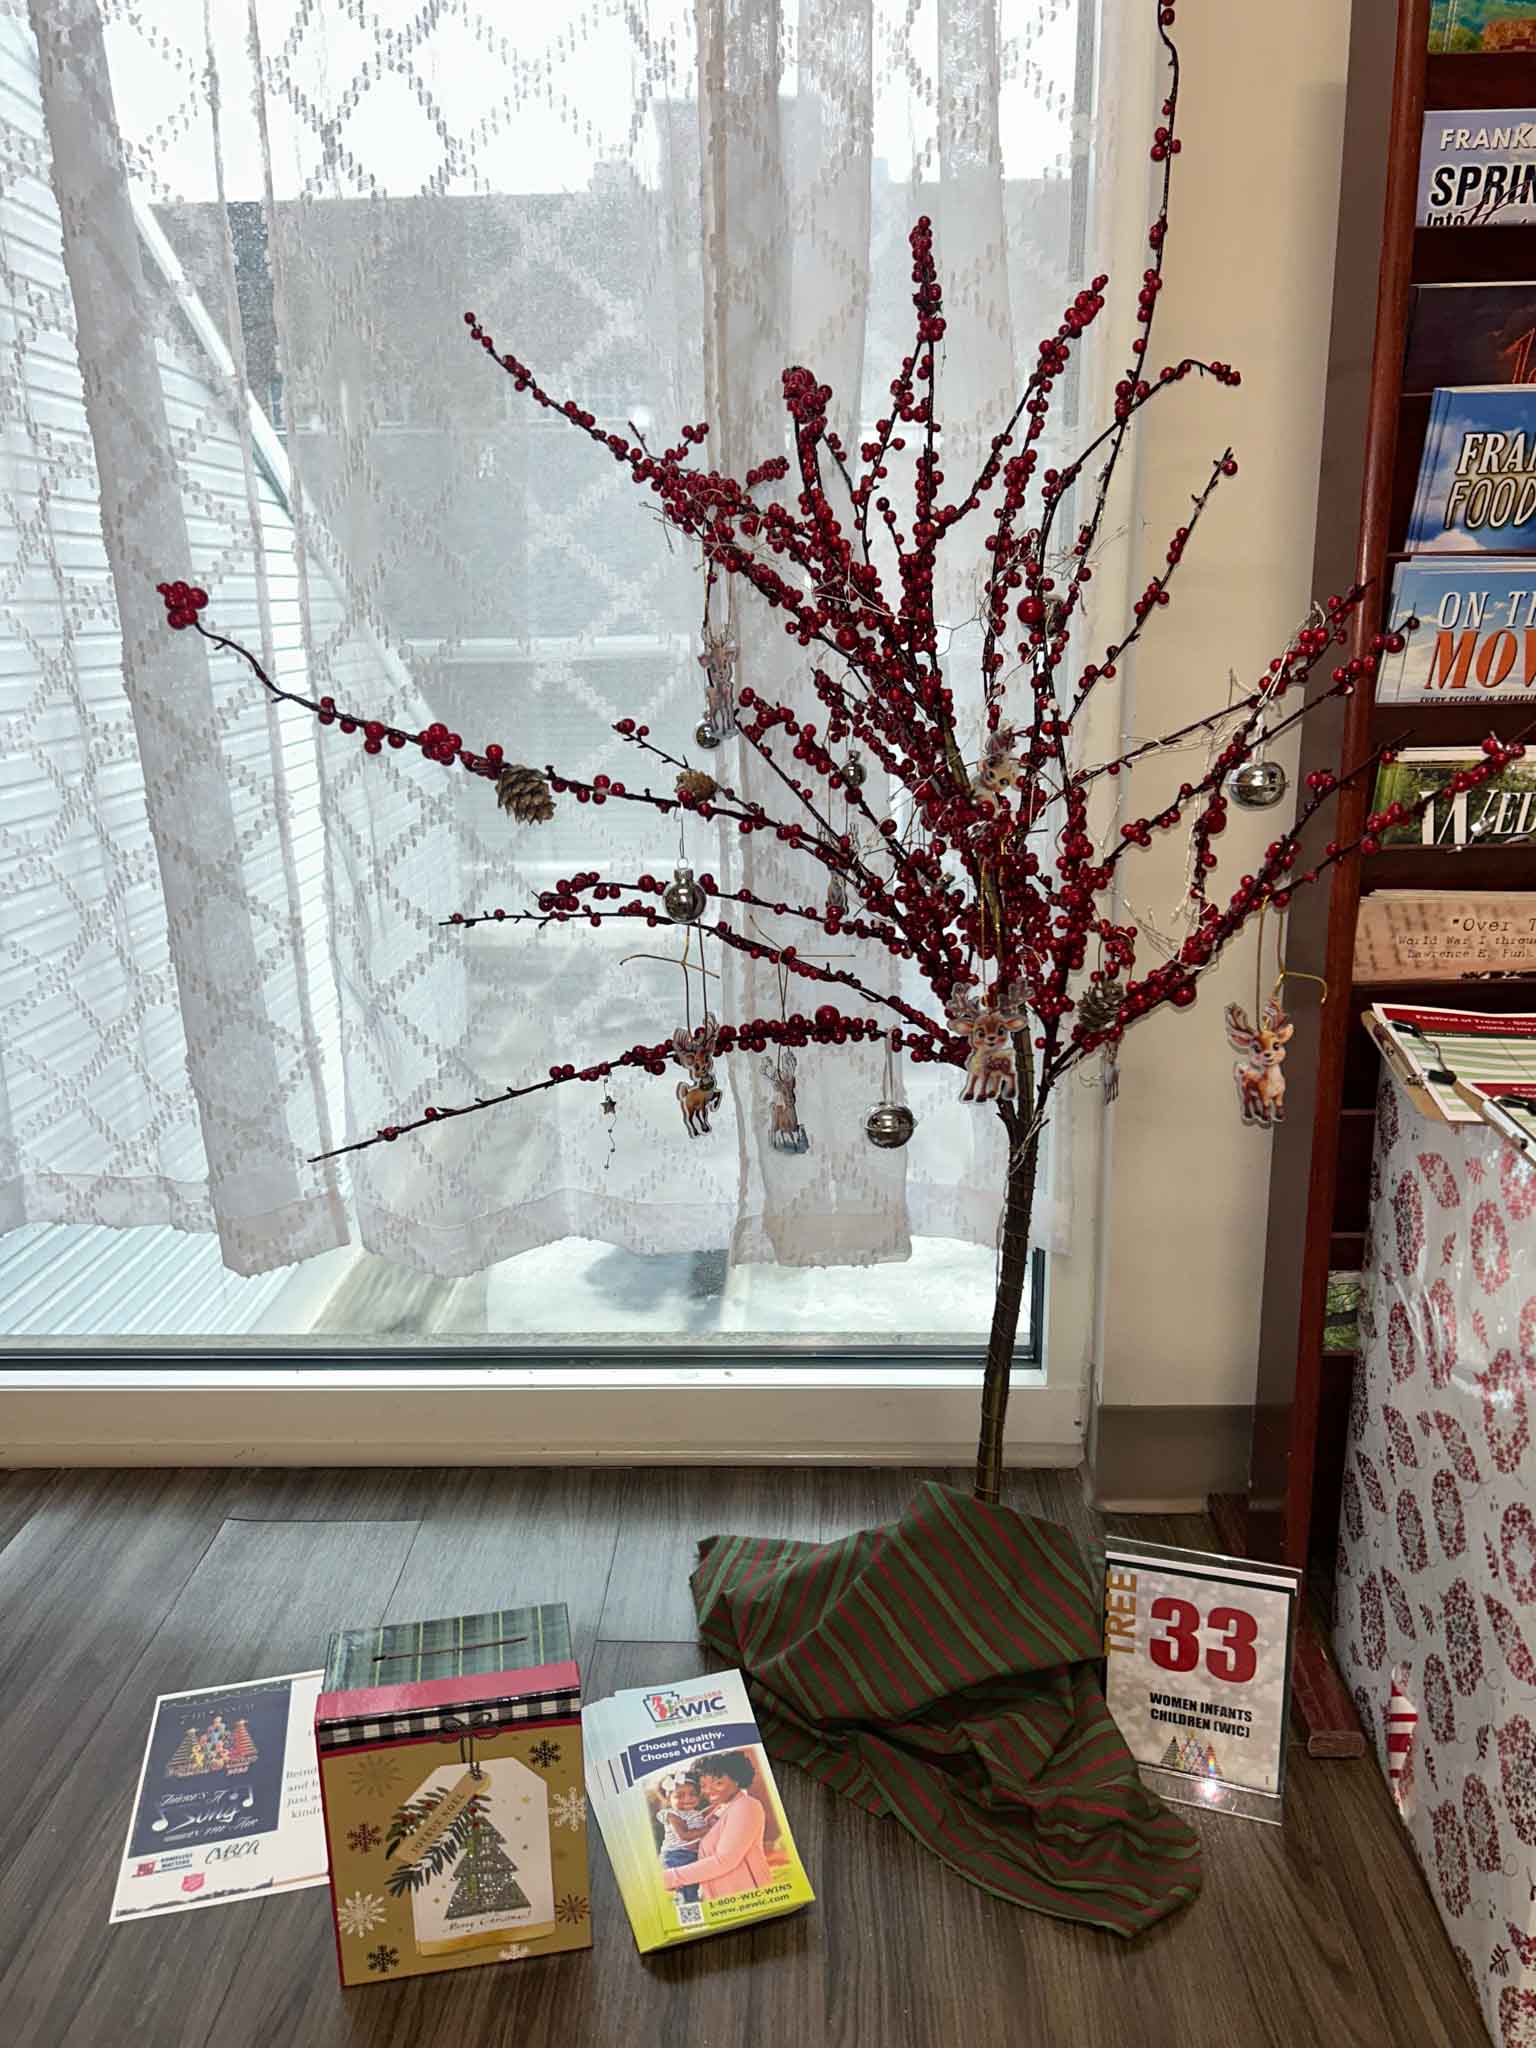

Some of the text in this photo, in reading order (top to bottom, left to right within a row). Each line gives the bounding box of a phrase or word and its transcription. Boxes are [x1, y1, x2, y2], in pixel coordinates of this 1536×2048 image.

[1440, 127, 1536, 151] FRANK
[1438, 591, 1490, 630] ON
[1105, 1567, 1137, 1657] TREE
[1149, 1597, 1258, 1683] 33
[680, 1696, 726, 1717] WIC
[1149, 1692, 1252, 1722] WOMEN INFANTS
[1150, 1708, 1250, 1738] CHILDREN (WIC)
[638, 1731, 725, 1752] Choose Healthy.
[640, 1740, 716, 1762] Choose WIC!
